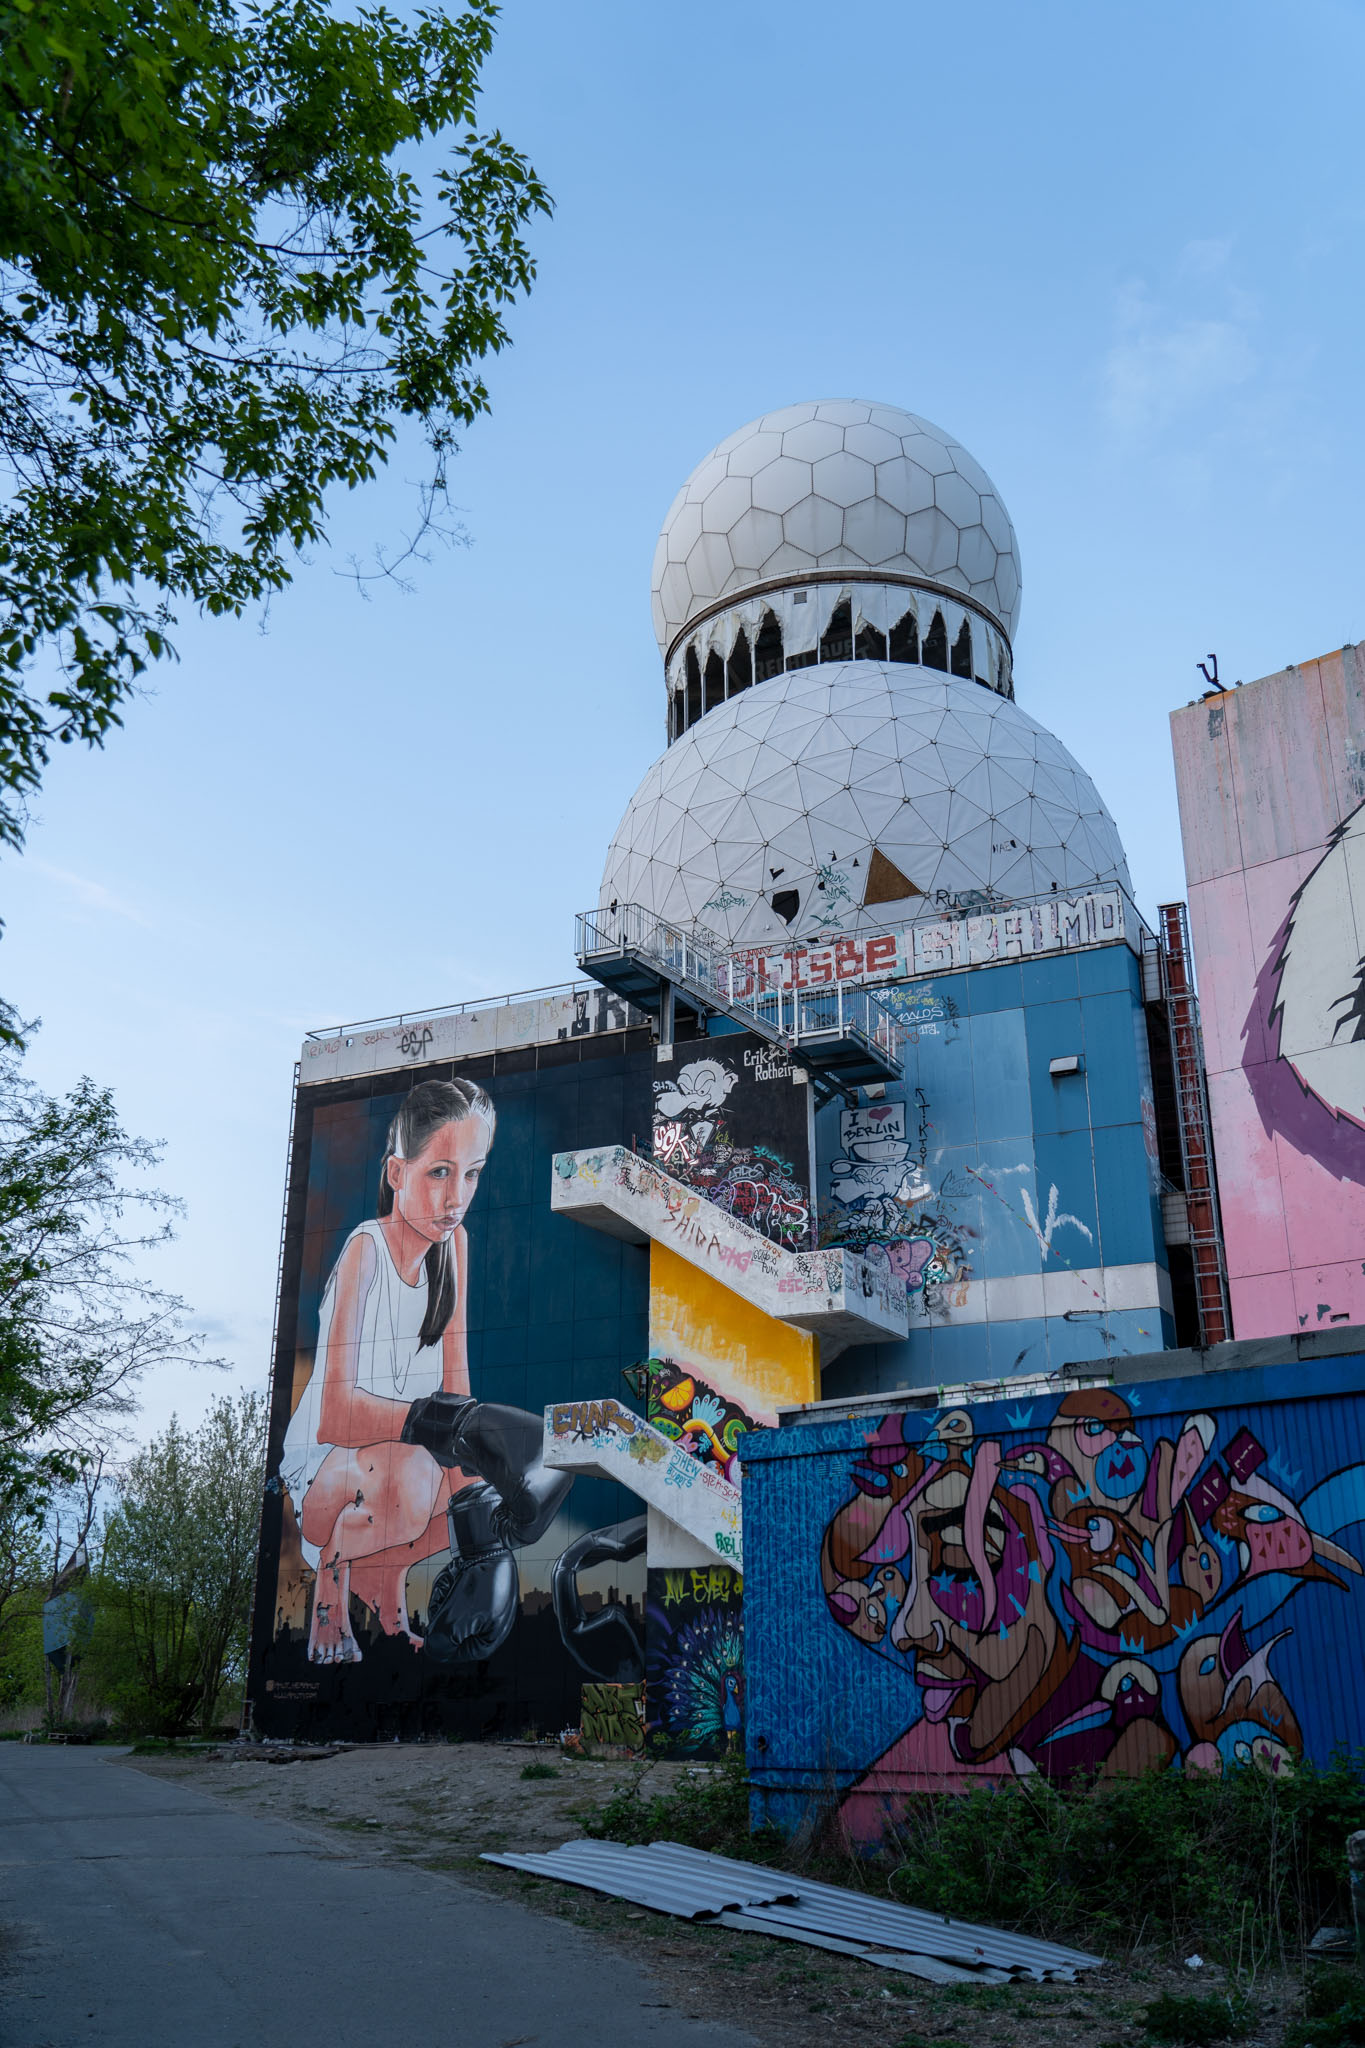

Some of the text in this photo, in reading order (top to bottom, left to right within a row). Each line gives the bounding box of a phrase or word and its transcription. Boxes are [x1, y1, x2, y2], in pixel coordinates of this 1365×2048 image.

[743, 1047, 769, 1067] Erik
[848, 1112, 859, 1127] I
[843, 1121, 900, 1142] BERLIN
